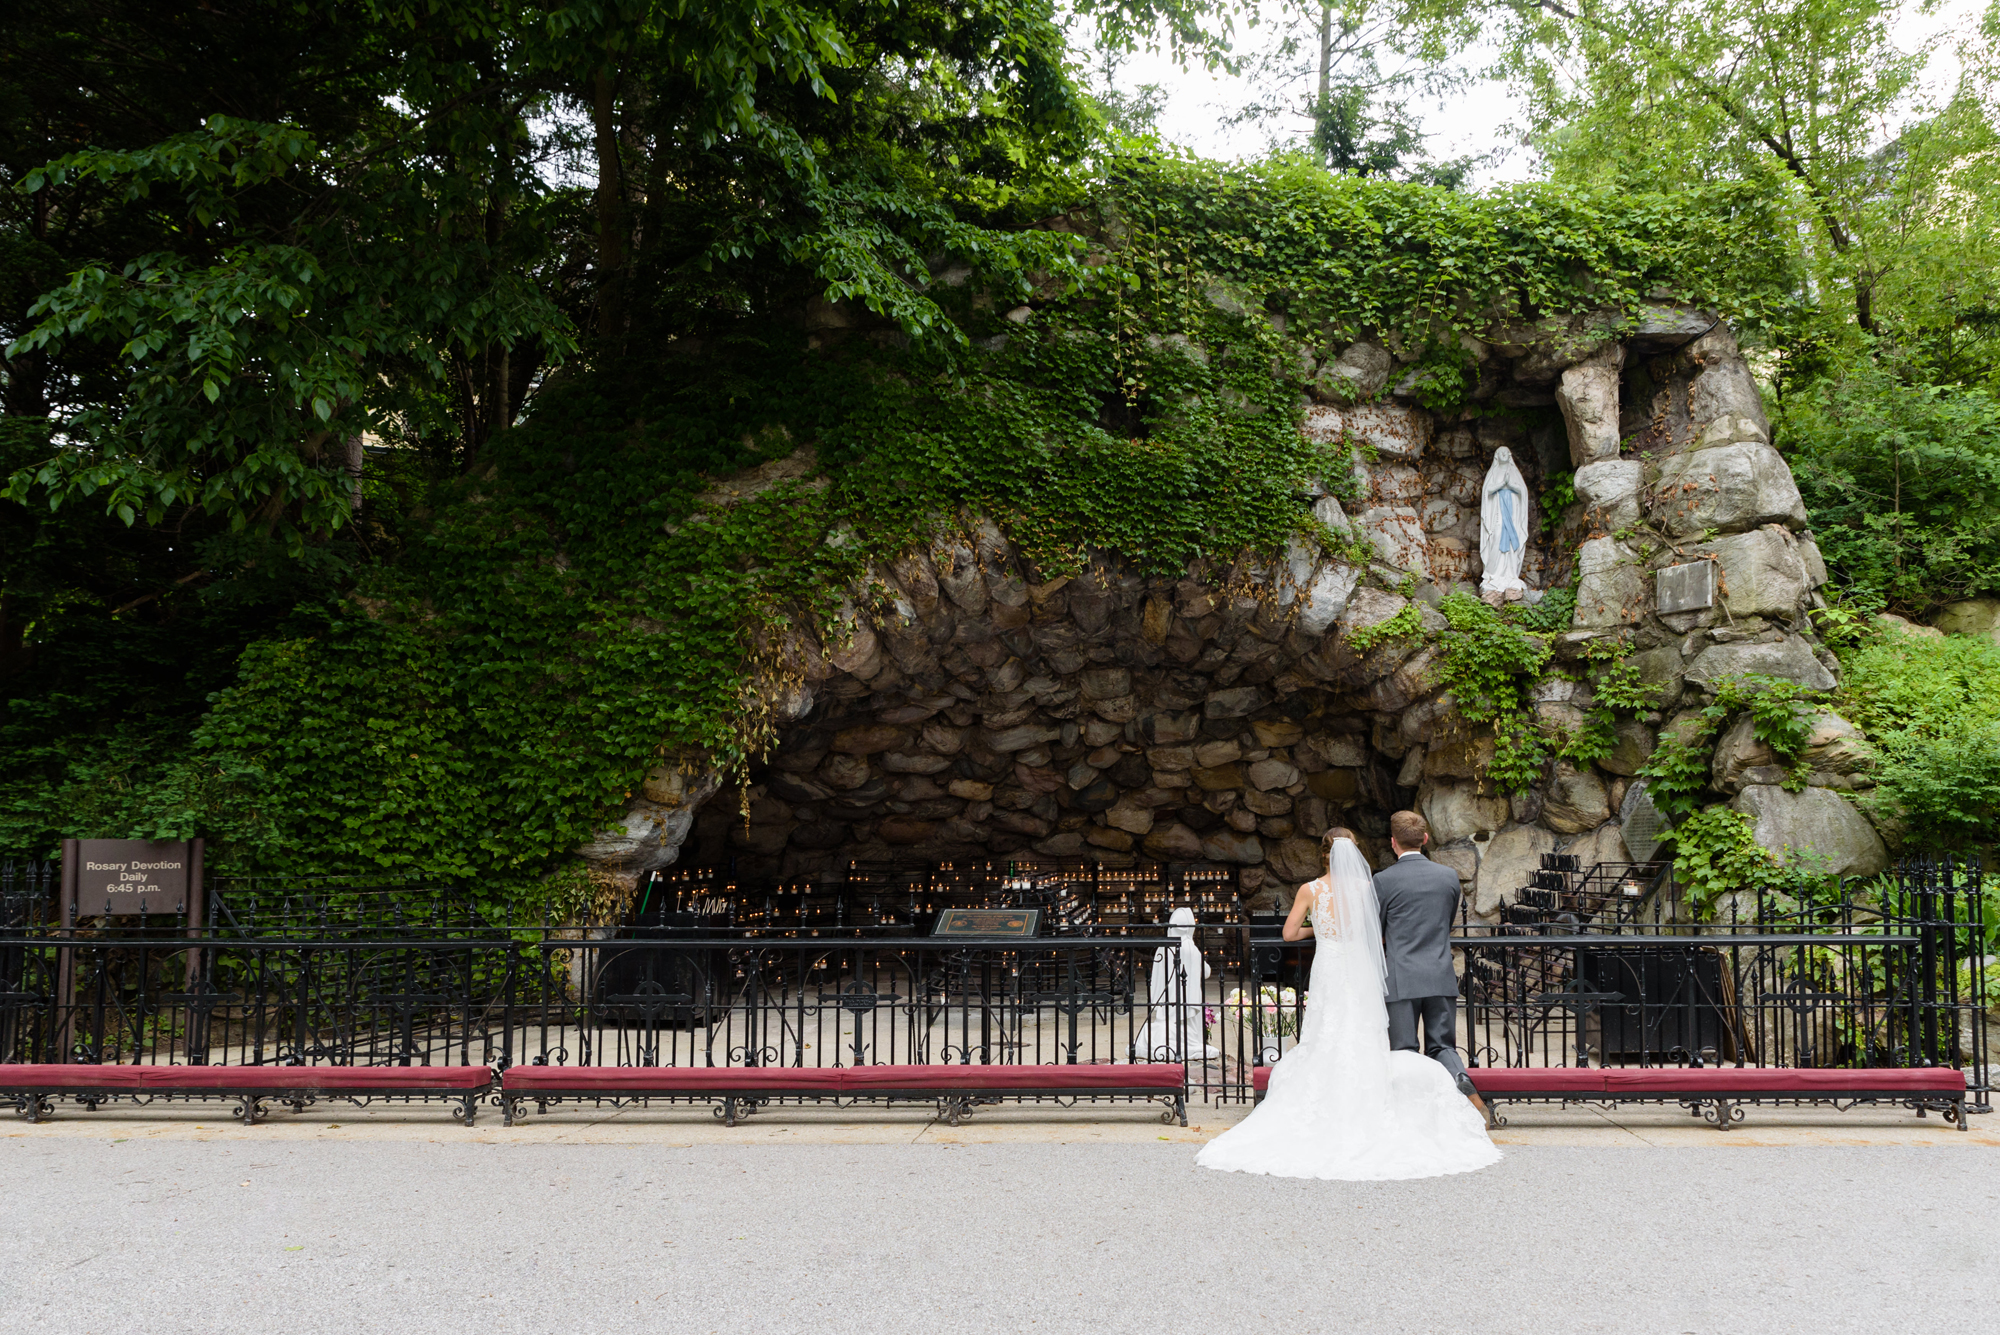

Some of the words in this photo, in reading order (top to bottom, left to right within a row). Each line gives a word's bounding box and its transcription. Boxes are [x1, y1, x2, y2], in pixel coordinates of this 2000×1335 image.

[86, 862, 127, 871] Rosary
[131, 860, 181, 870] Devotion
[120, 872, 148, 882] Daily
[107, 884, 133, 893] 6:45
[138, 885, 161, 894] p.m.
